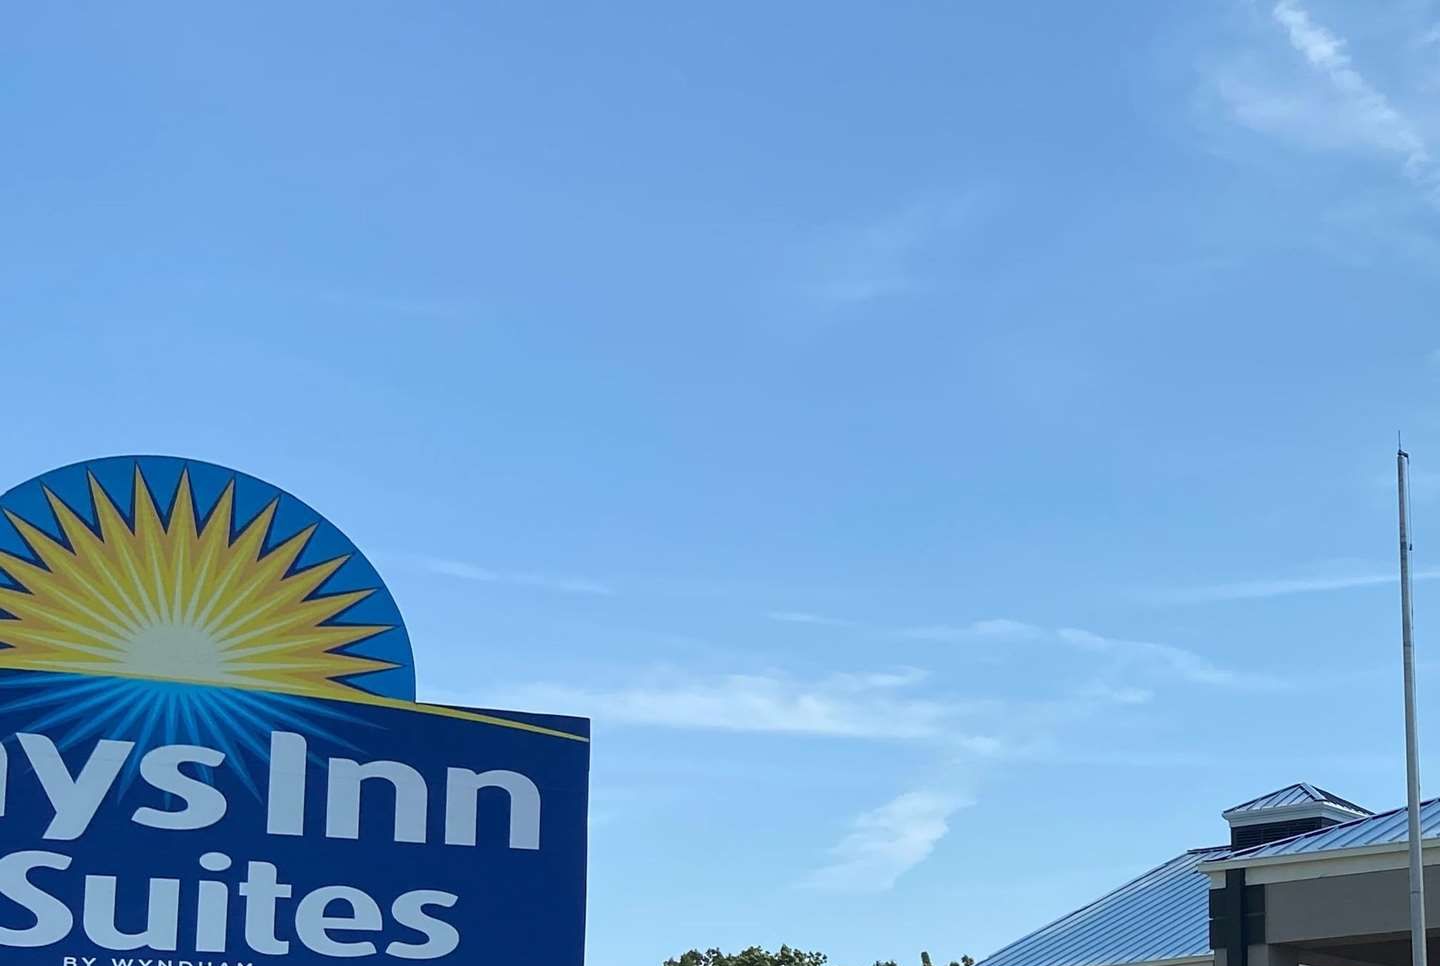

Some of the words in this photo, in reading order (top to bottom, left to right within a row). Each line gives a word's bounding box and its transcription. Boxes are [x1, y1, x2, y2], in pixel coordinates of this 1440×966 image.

[0, 732, 228, 840] ys
[267, 731, 541, 850] Inn
[0, 850, 460, 960] Suites
